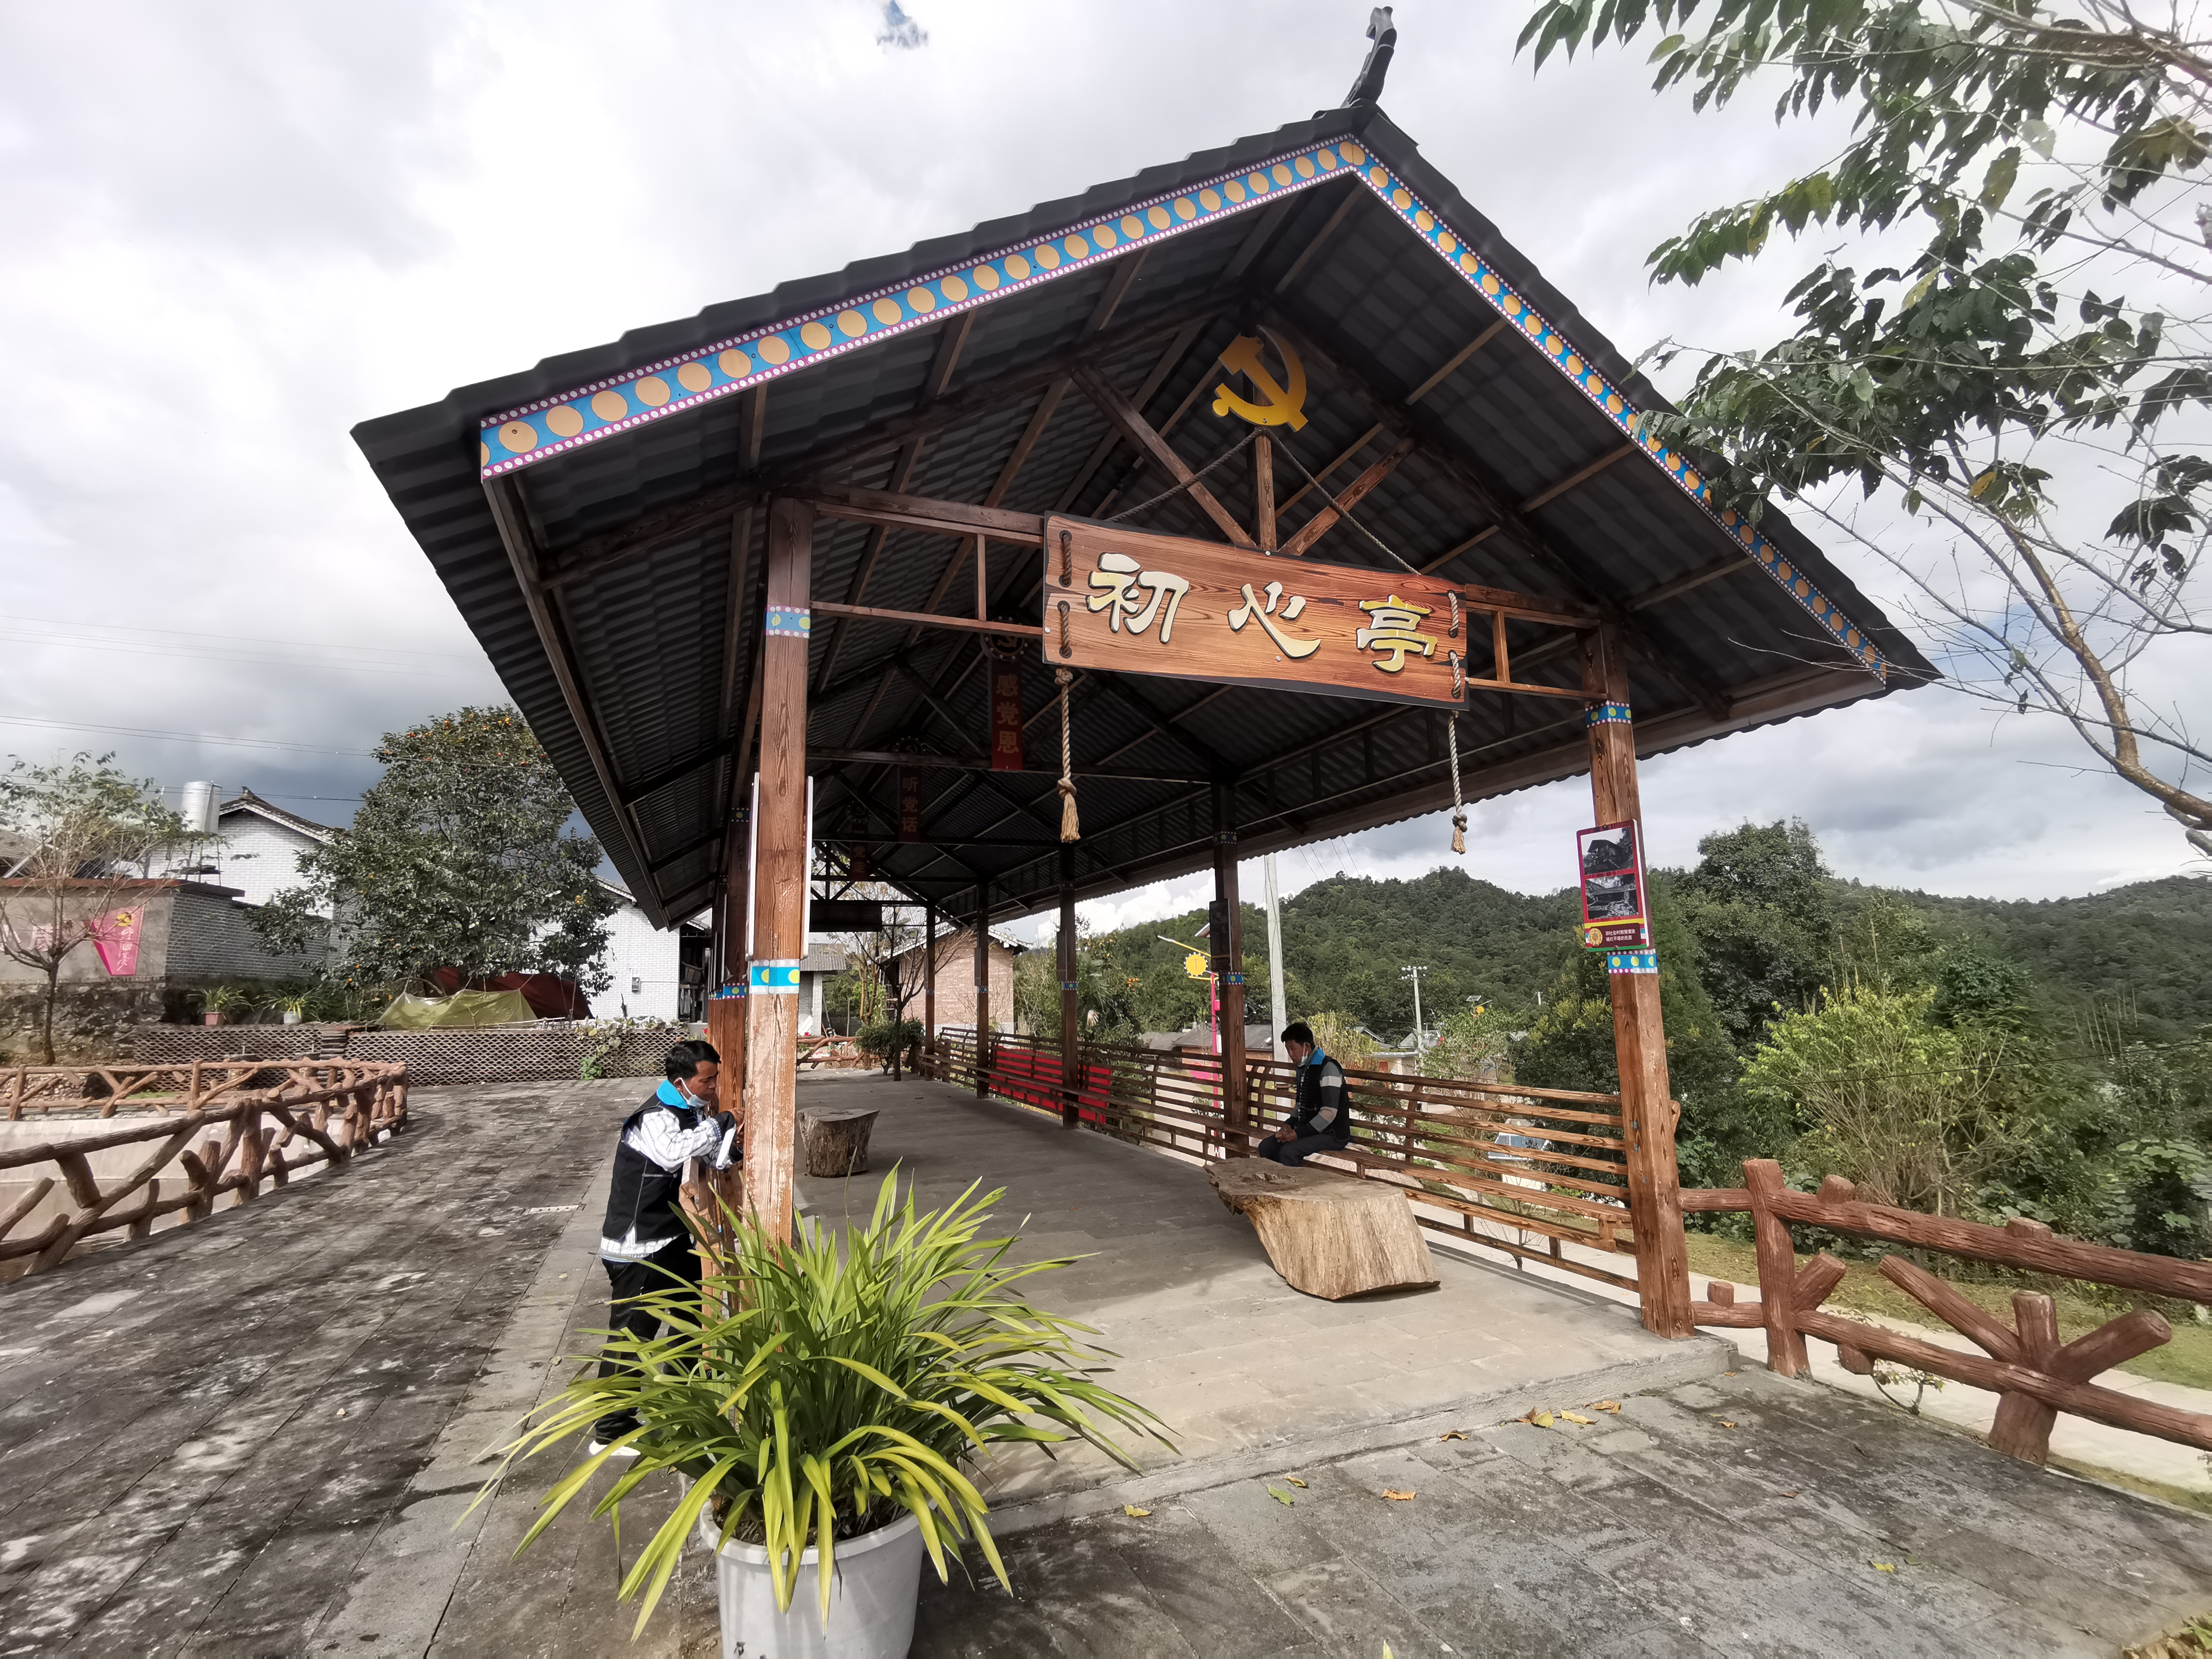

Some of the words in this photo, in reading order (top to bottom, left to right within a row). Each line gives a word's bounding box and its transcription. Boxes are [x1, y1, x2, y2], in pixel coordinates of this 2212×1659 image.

[1086, 551, 1438, 673] 初心亭
[996, 674, 1019, 754] 感党恩
[901, 776, 919, 833] 听党话
